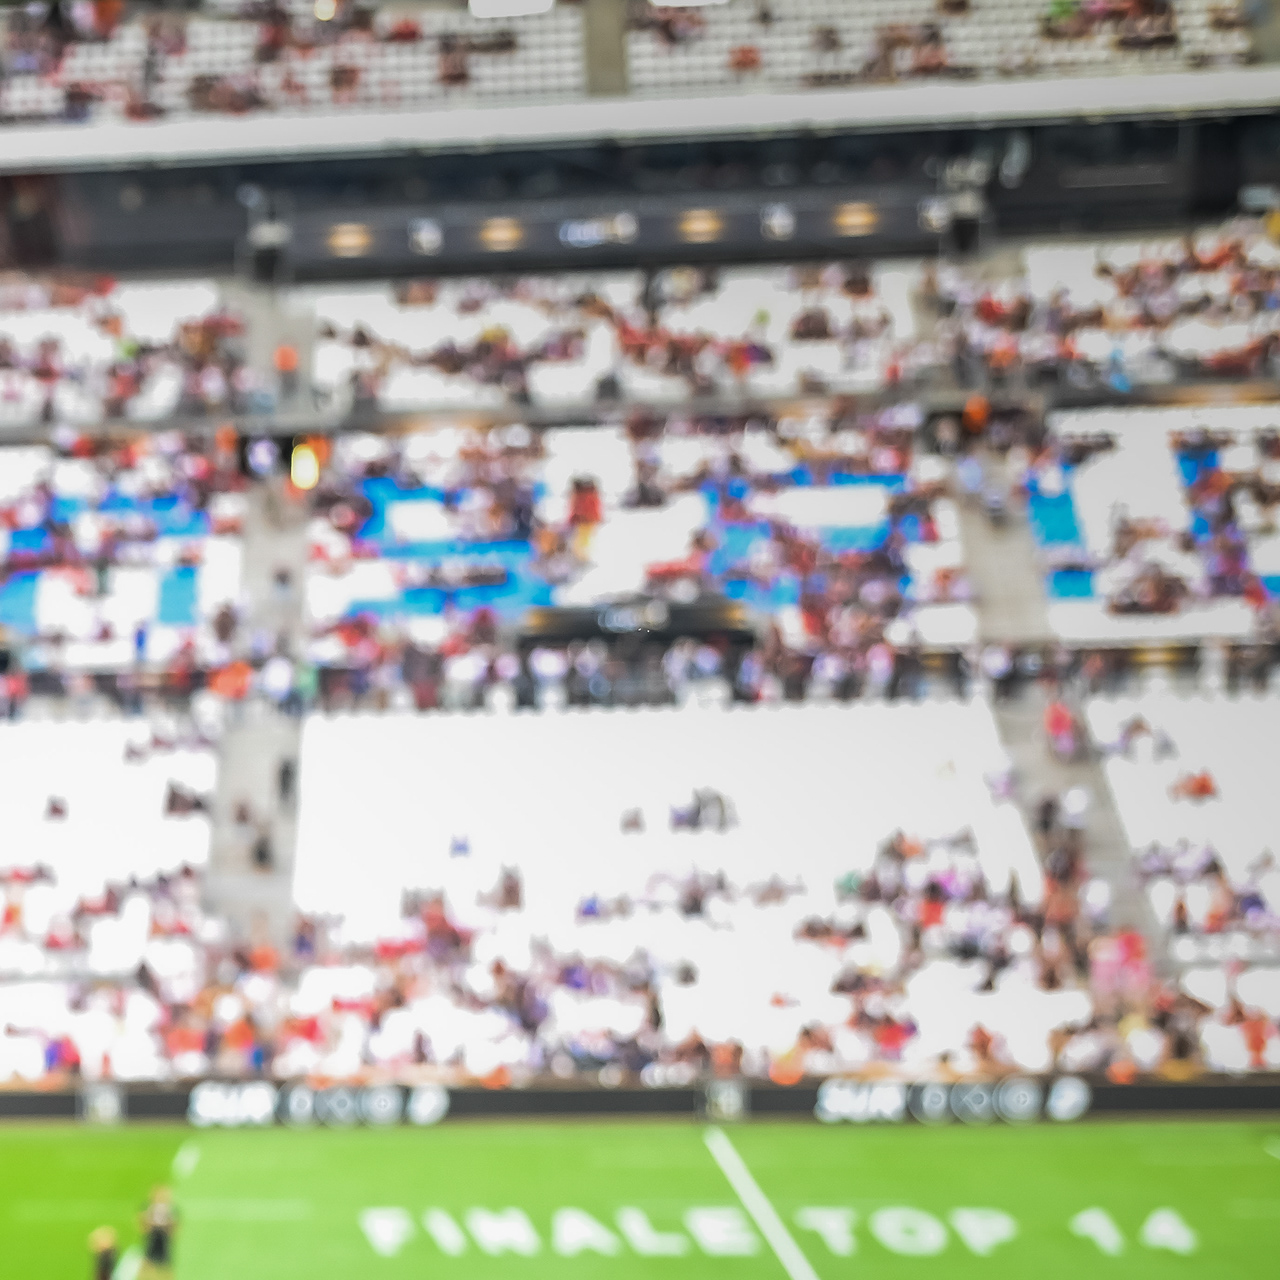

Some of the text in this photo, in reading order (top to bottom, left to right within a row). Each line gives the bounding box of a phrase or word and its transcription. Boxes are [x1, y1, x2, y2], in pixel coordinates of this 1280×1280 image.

[359, 1206, 1198, 1257] FINALE TOP 14
